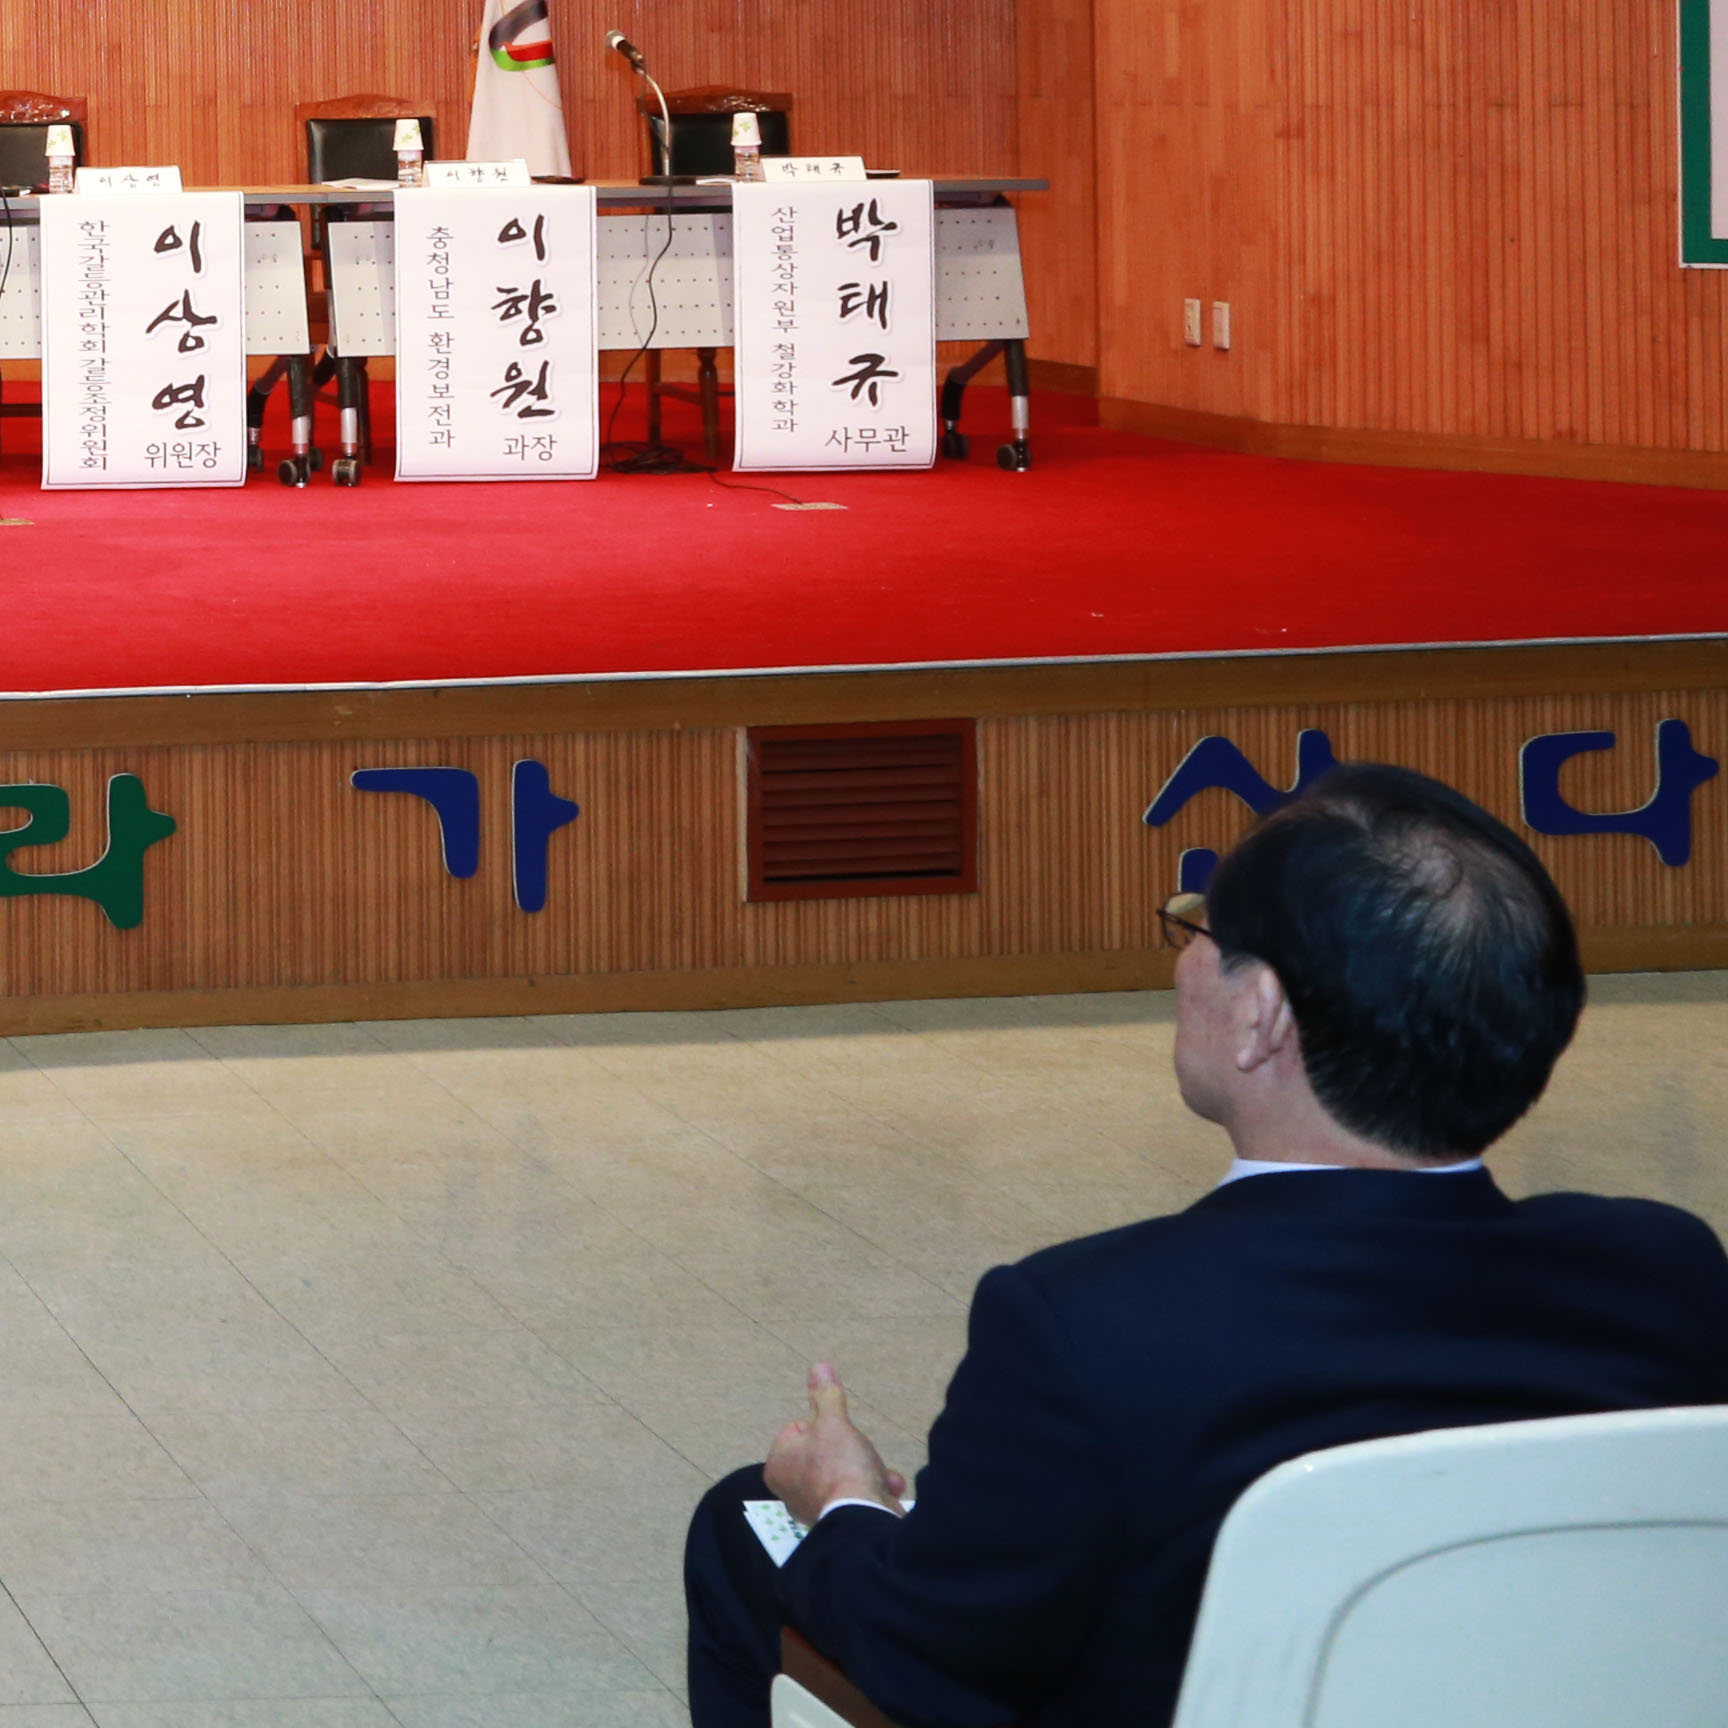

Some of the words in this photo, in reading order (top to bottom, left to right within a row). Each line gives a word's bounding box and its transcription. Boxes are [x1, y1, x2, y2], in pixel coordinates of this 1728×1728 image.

[429, 226, 454, 319] 충청남도
[489, 213, 558, 420] 이향원
[771, 206, 798, 333] 산업통상자원부
[831, 197, 900, 407] 박태규
[145, 220, 218, 431] 이상영
[429, 331, 455, 448] 환경보전과
[774, 343, 798, 433] 철강화학과
[825, 425, 910, 453] 사무관
[145, 441, 222, 469] 위원장
[504, 434, 558, 462] 과장
